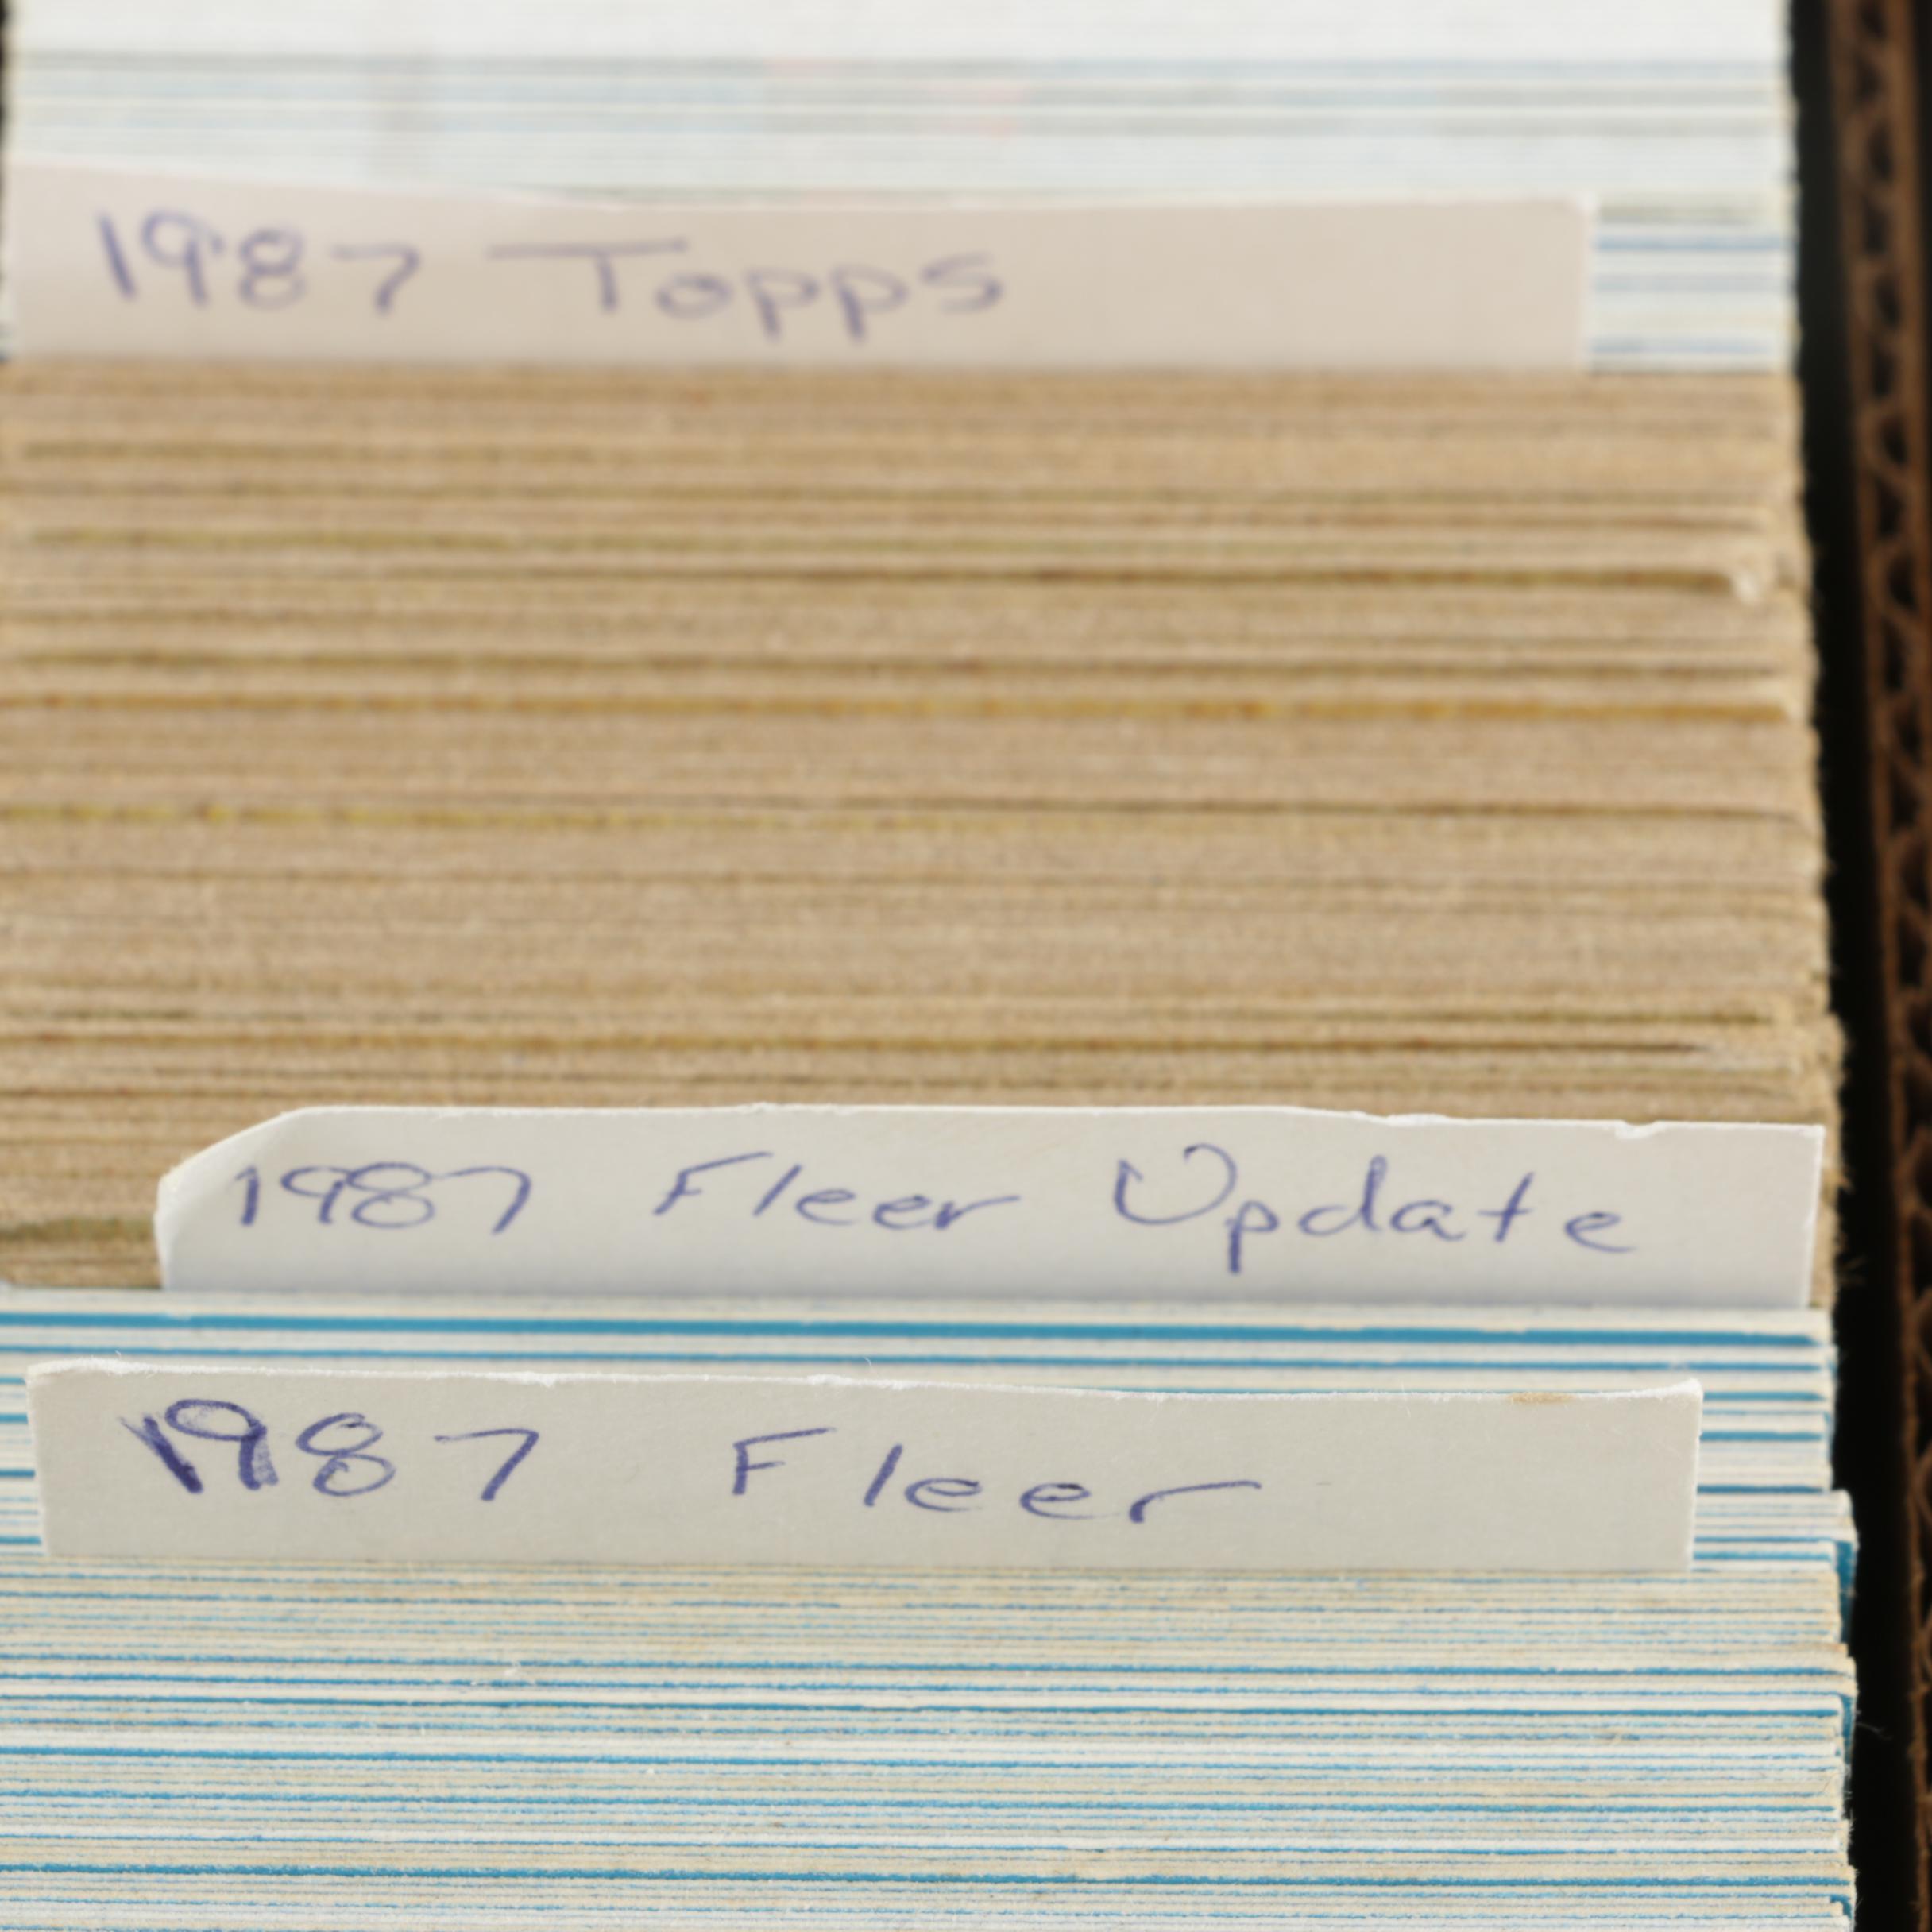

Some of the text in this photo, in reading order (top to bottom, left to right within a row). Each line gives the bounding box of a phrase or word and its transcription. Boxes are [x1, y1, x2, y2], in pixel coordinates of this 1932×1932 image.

[96, 208, 1007, 342] 1987 Topps
[234, 1142, 1636, 1276] 1987 Fleer Update
[120, 1397, 1262, 1525] 1987 Fleer
